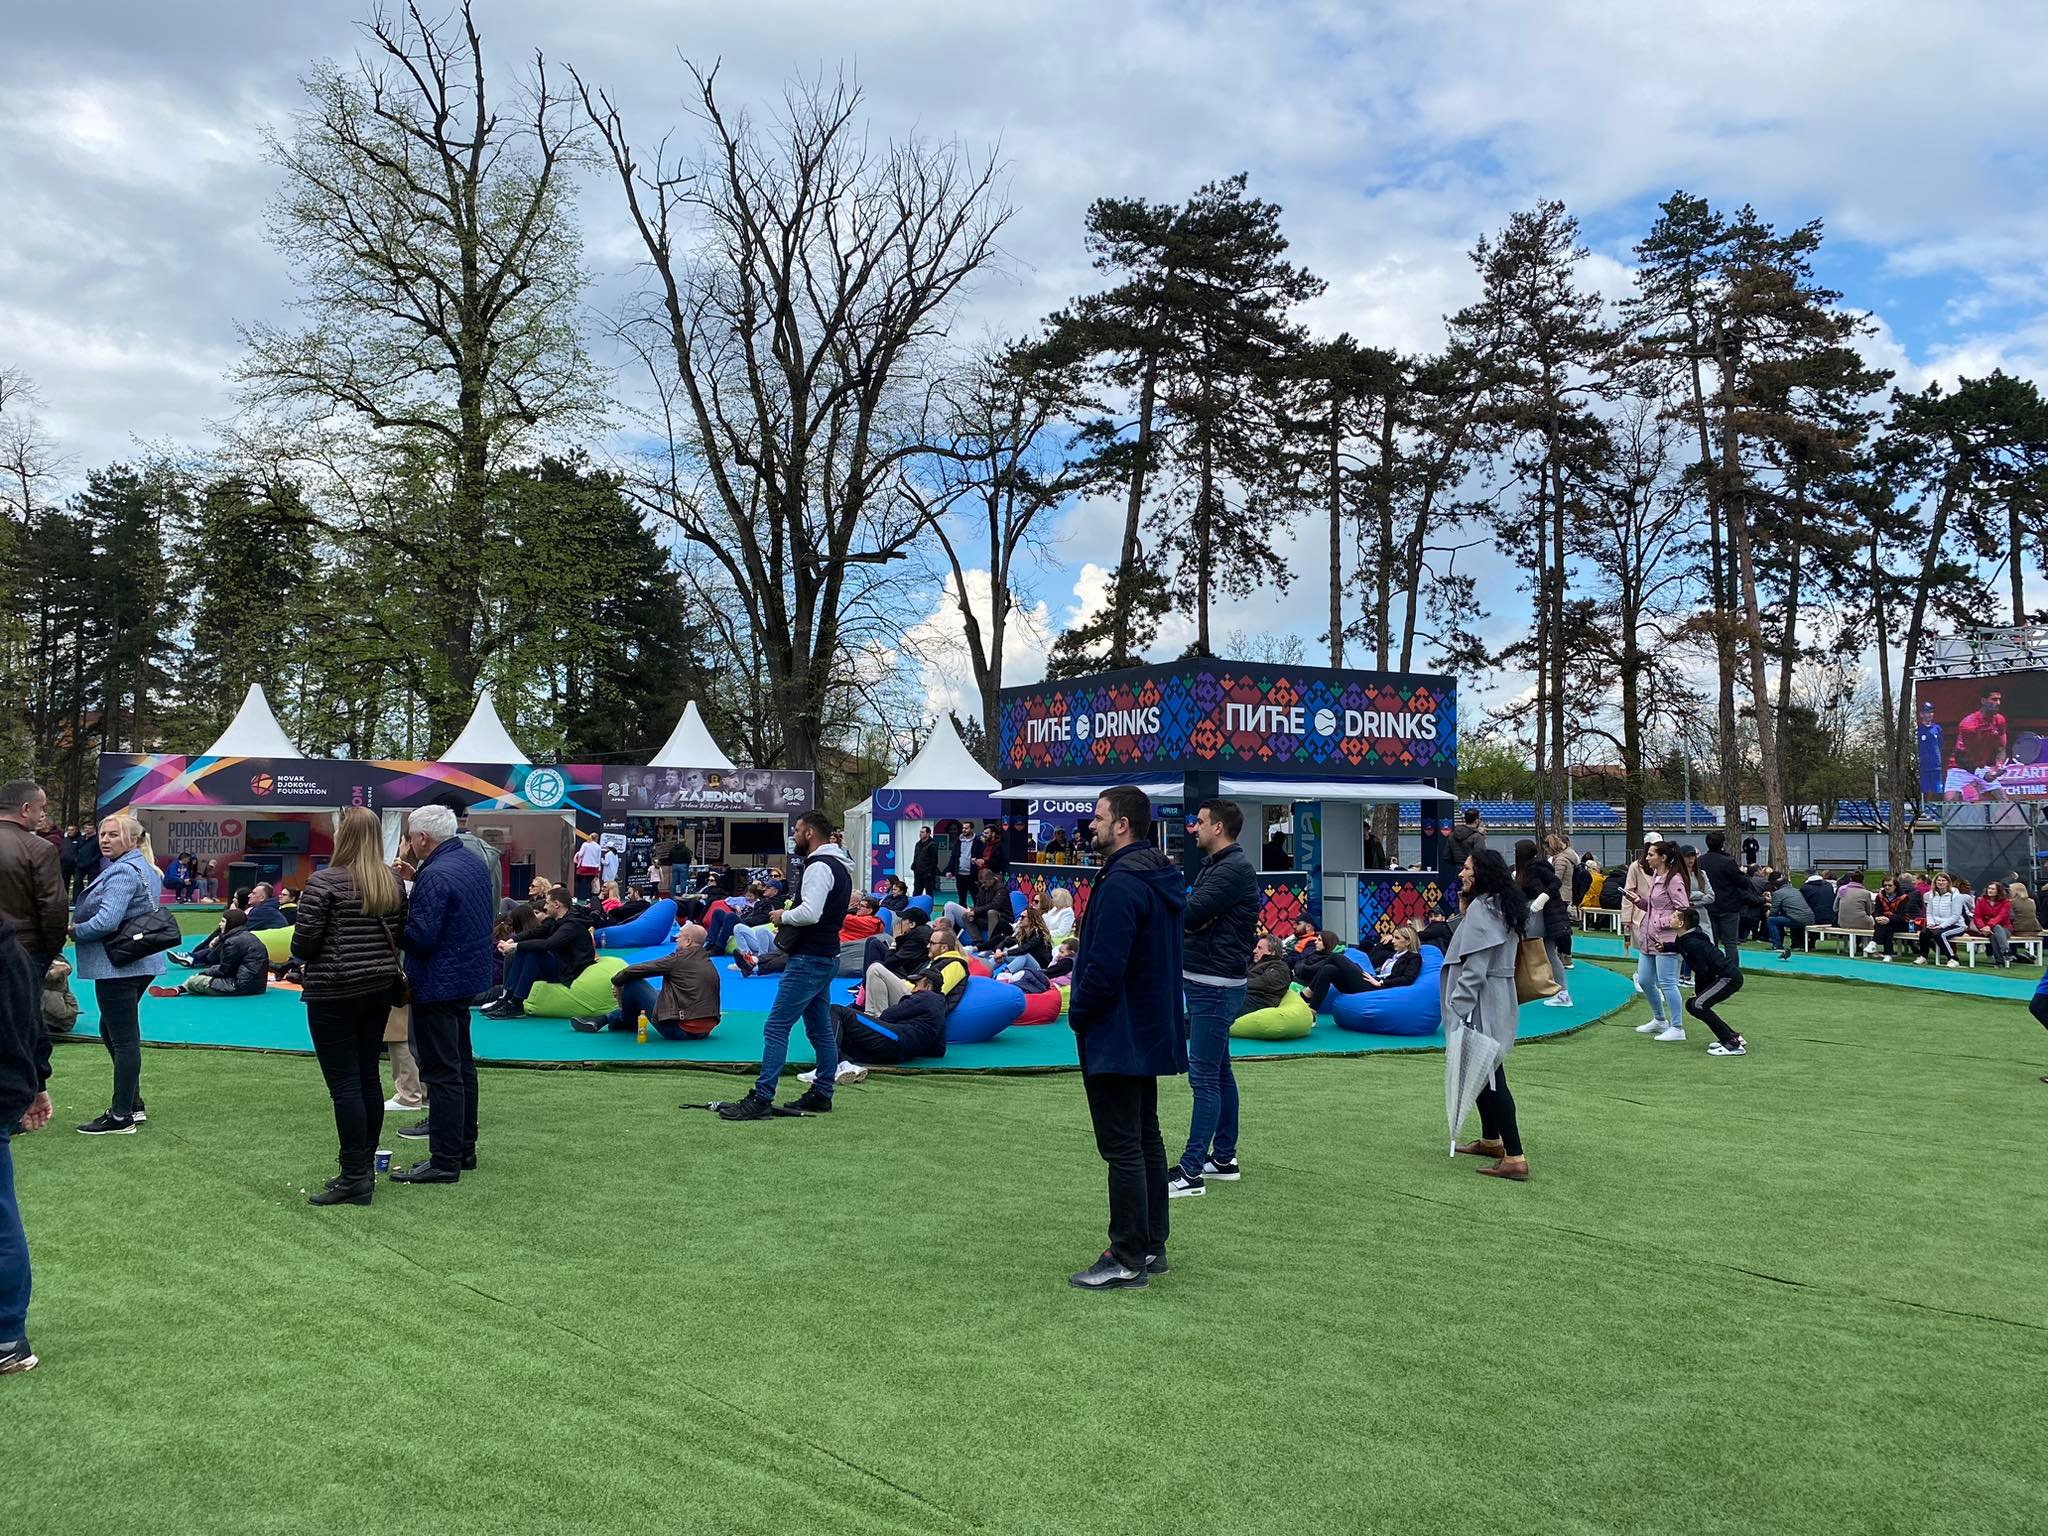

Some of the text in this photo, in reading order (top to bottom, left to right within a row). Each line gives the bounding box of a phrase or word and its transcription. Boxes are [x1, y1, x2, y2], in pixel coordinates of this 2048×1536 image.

[1027, 706, 1160, 743] ПИЋЕ DRINKS
[1226, 703, 1437, 740] ПИЋЕ DRINKS
[607, 783, 630, 797] 21
[782, 787, 805, 801] 22
[1043, 800, 1093, 813] Cubes
[168, 820, 218, 837] PODRŠKA
[168, 838, 240, 854] NE PERFEKCIJA
